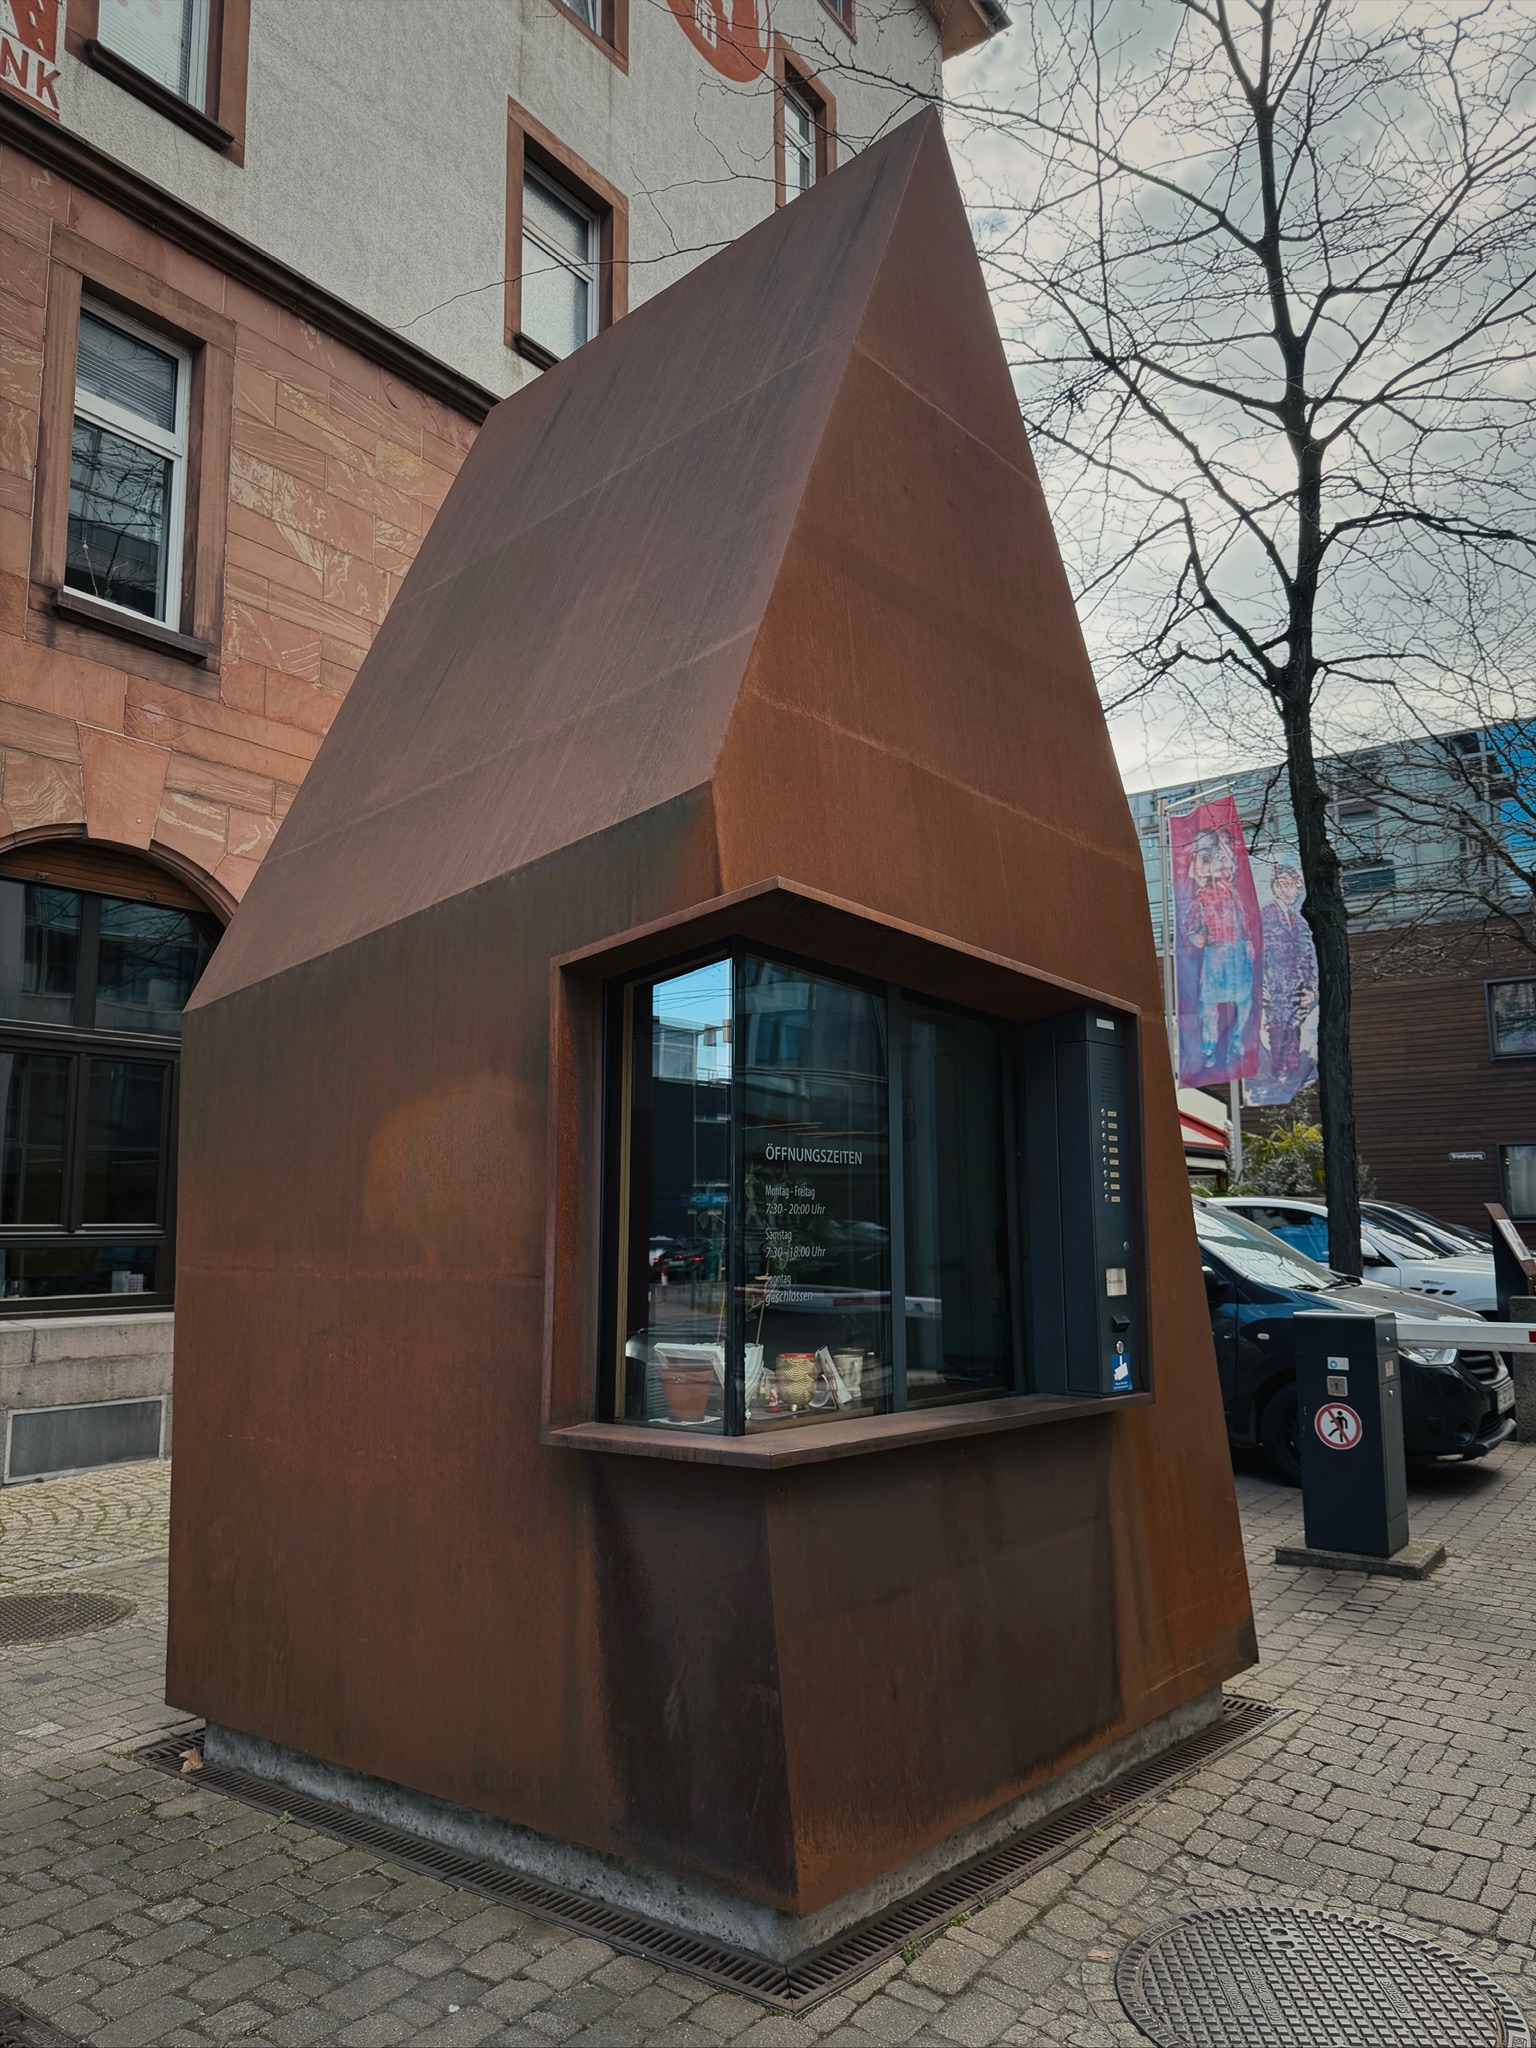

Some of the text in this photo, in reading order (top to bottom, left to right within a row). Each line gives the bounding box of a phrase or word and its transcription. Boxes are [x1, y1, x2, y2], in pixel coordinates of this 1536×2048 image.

[765, 1143, 863, 1165] ÖFFNUNGSZEITEN
[765, 1185, 790, 1200] Montag
[794, 1186, 816, 1200] Freitag
[765, 1203, 783, 1215] 7:30
[788, 1203, 811, 1215] 20:00
[811, 1203, 826, 1215] Uhr
[765, 1229, 792, 1242] Samstag
[765, 1247, 783, 1258] 7:30
[789, 1246, 811, 1258] 18:00
[811, 1246, 827, 1257] Uhr
[765, 1272, 792, 1286] Sonntag
[765, 1290, 813, 1307] geschlossen
[1379, 1979, 1411, 2014] BUDERUS
